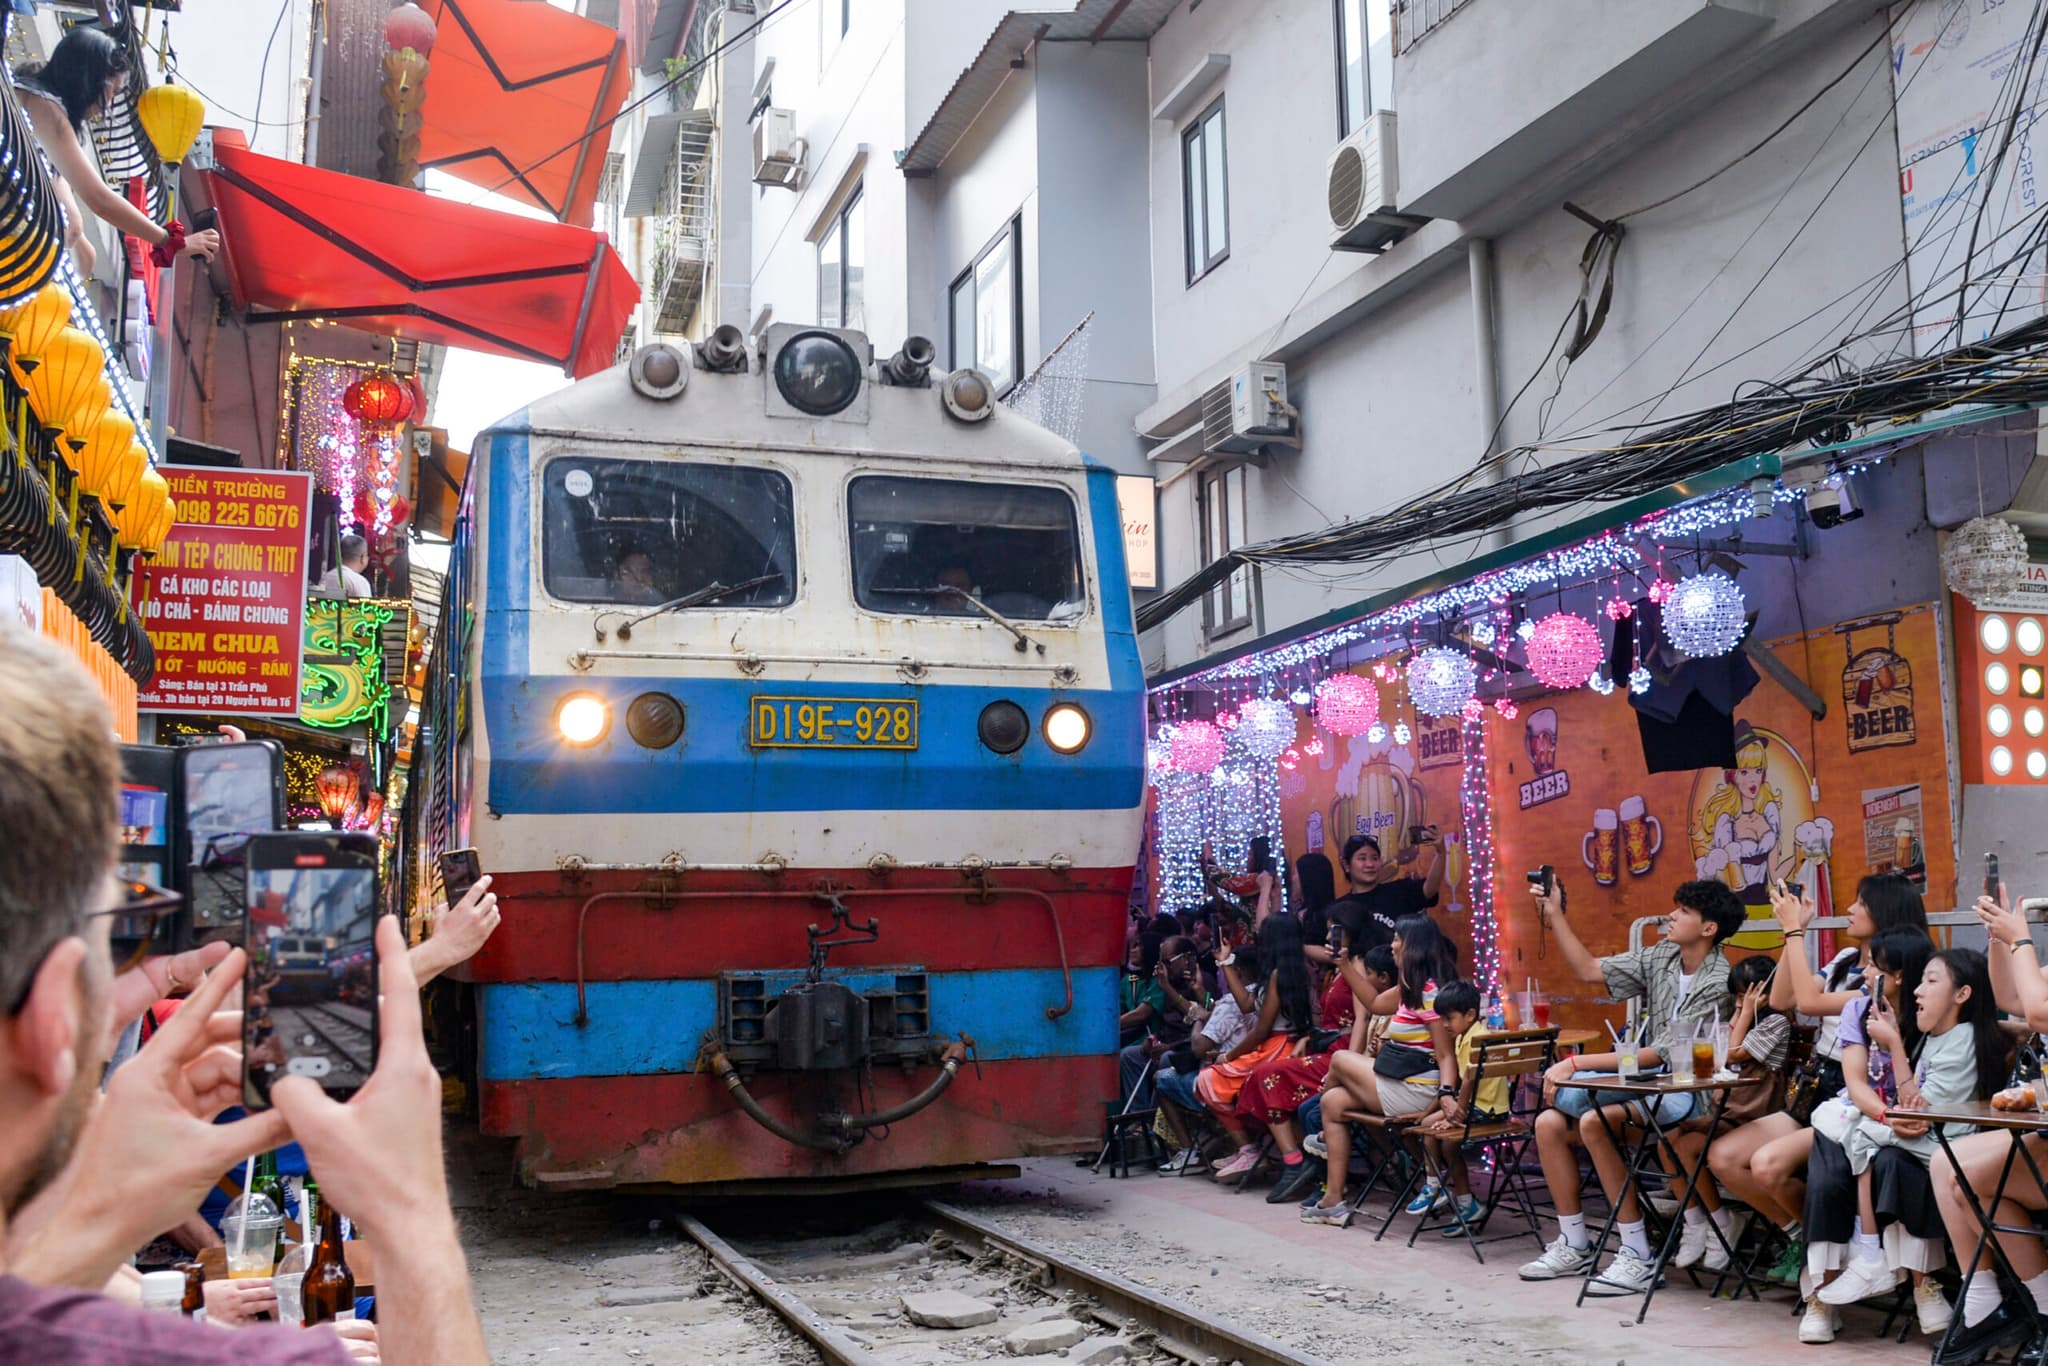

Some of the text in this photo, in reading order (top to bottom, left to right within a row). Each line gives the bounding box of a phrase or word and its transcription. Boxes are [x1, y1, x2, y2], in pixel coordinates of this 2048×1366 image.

[213, 477, 287, 500] TRƯỜNG
[177, 500, 299, 528] 098 225 6676
[267, 545, 298, 577] THỊT
[160, 574, 272, 602] CÁ KHO CÁC LOẠI
[164, 597, 192, 620] CHẢ
[203, 601, 241, 622] BÁNH
[243, 604, 289, 625] CHƯNG
[147, 631, 280, 655] NEM CHUA
[757, 703, 911, 742] D19E-928
[1853, 704, 1912, 740] BEER
[1420, 727, 1462, 758] BEER
[1520, 772, 1569, 806] BEER
